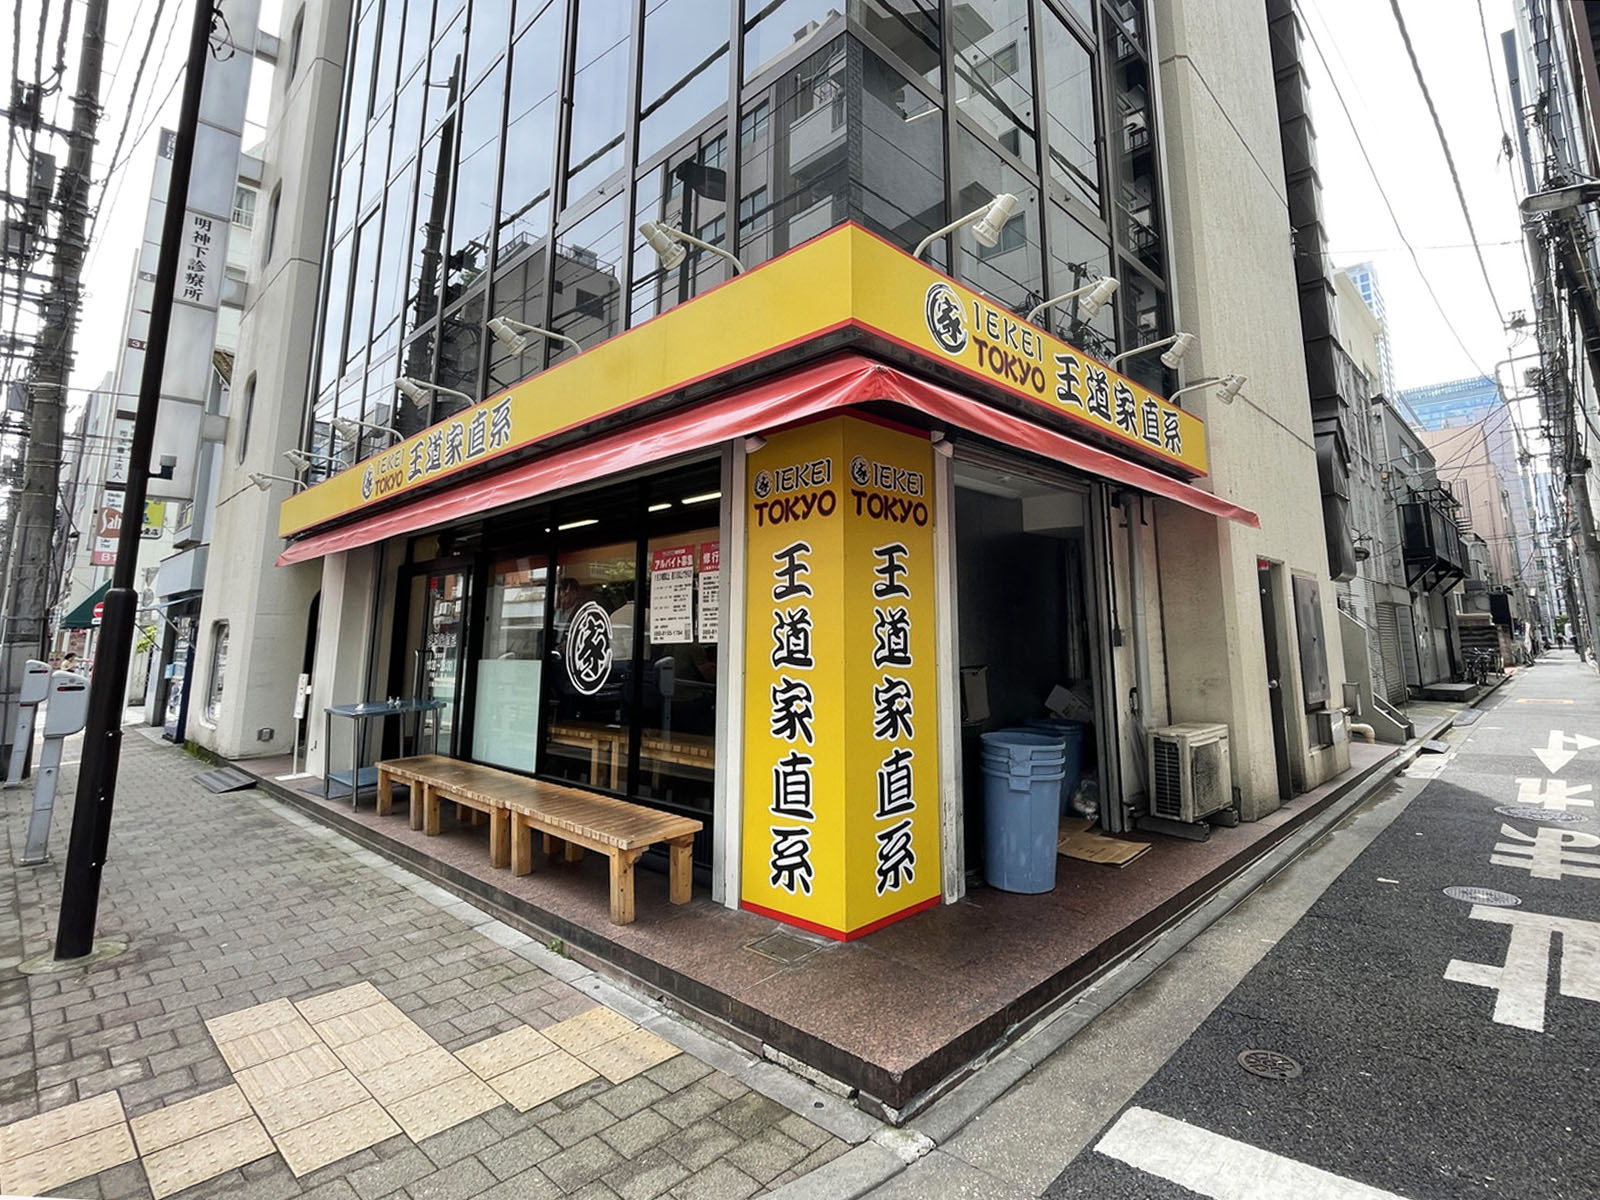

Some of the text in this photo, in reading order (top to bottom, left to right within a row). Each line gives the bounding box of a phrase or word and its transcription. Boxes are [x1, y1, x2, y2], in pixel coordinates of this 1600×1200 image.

[181, 216, 212, 302] 明神下診療所
[972, 300, 1044, 362] IEKEI
[972, 335, 1046, 393] TOKYO
[1053, 352, 1182, 455] 王道家直系
[375, 449, 404, 476] IEKEI
[408, 396, 512, 482] 王道家直系
[374, 470, 403, 497] TOKYO
[774, 457, 832, 493] IEKEI
[871, 461, 925, 497] IEKEI
[753, 489, 837, 527] TOKYO
[851, 489, 929, 527] TOKYO
[769, 540, 815, 898] 王道家直系
[871, 540, 917, 898] 王道家直系
